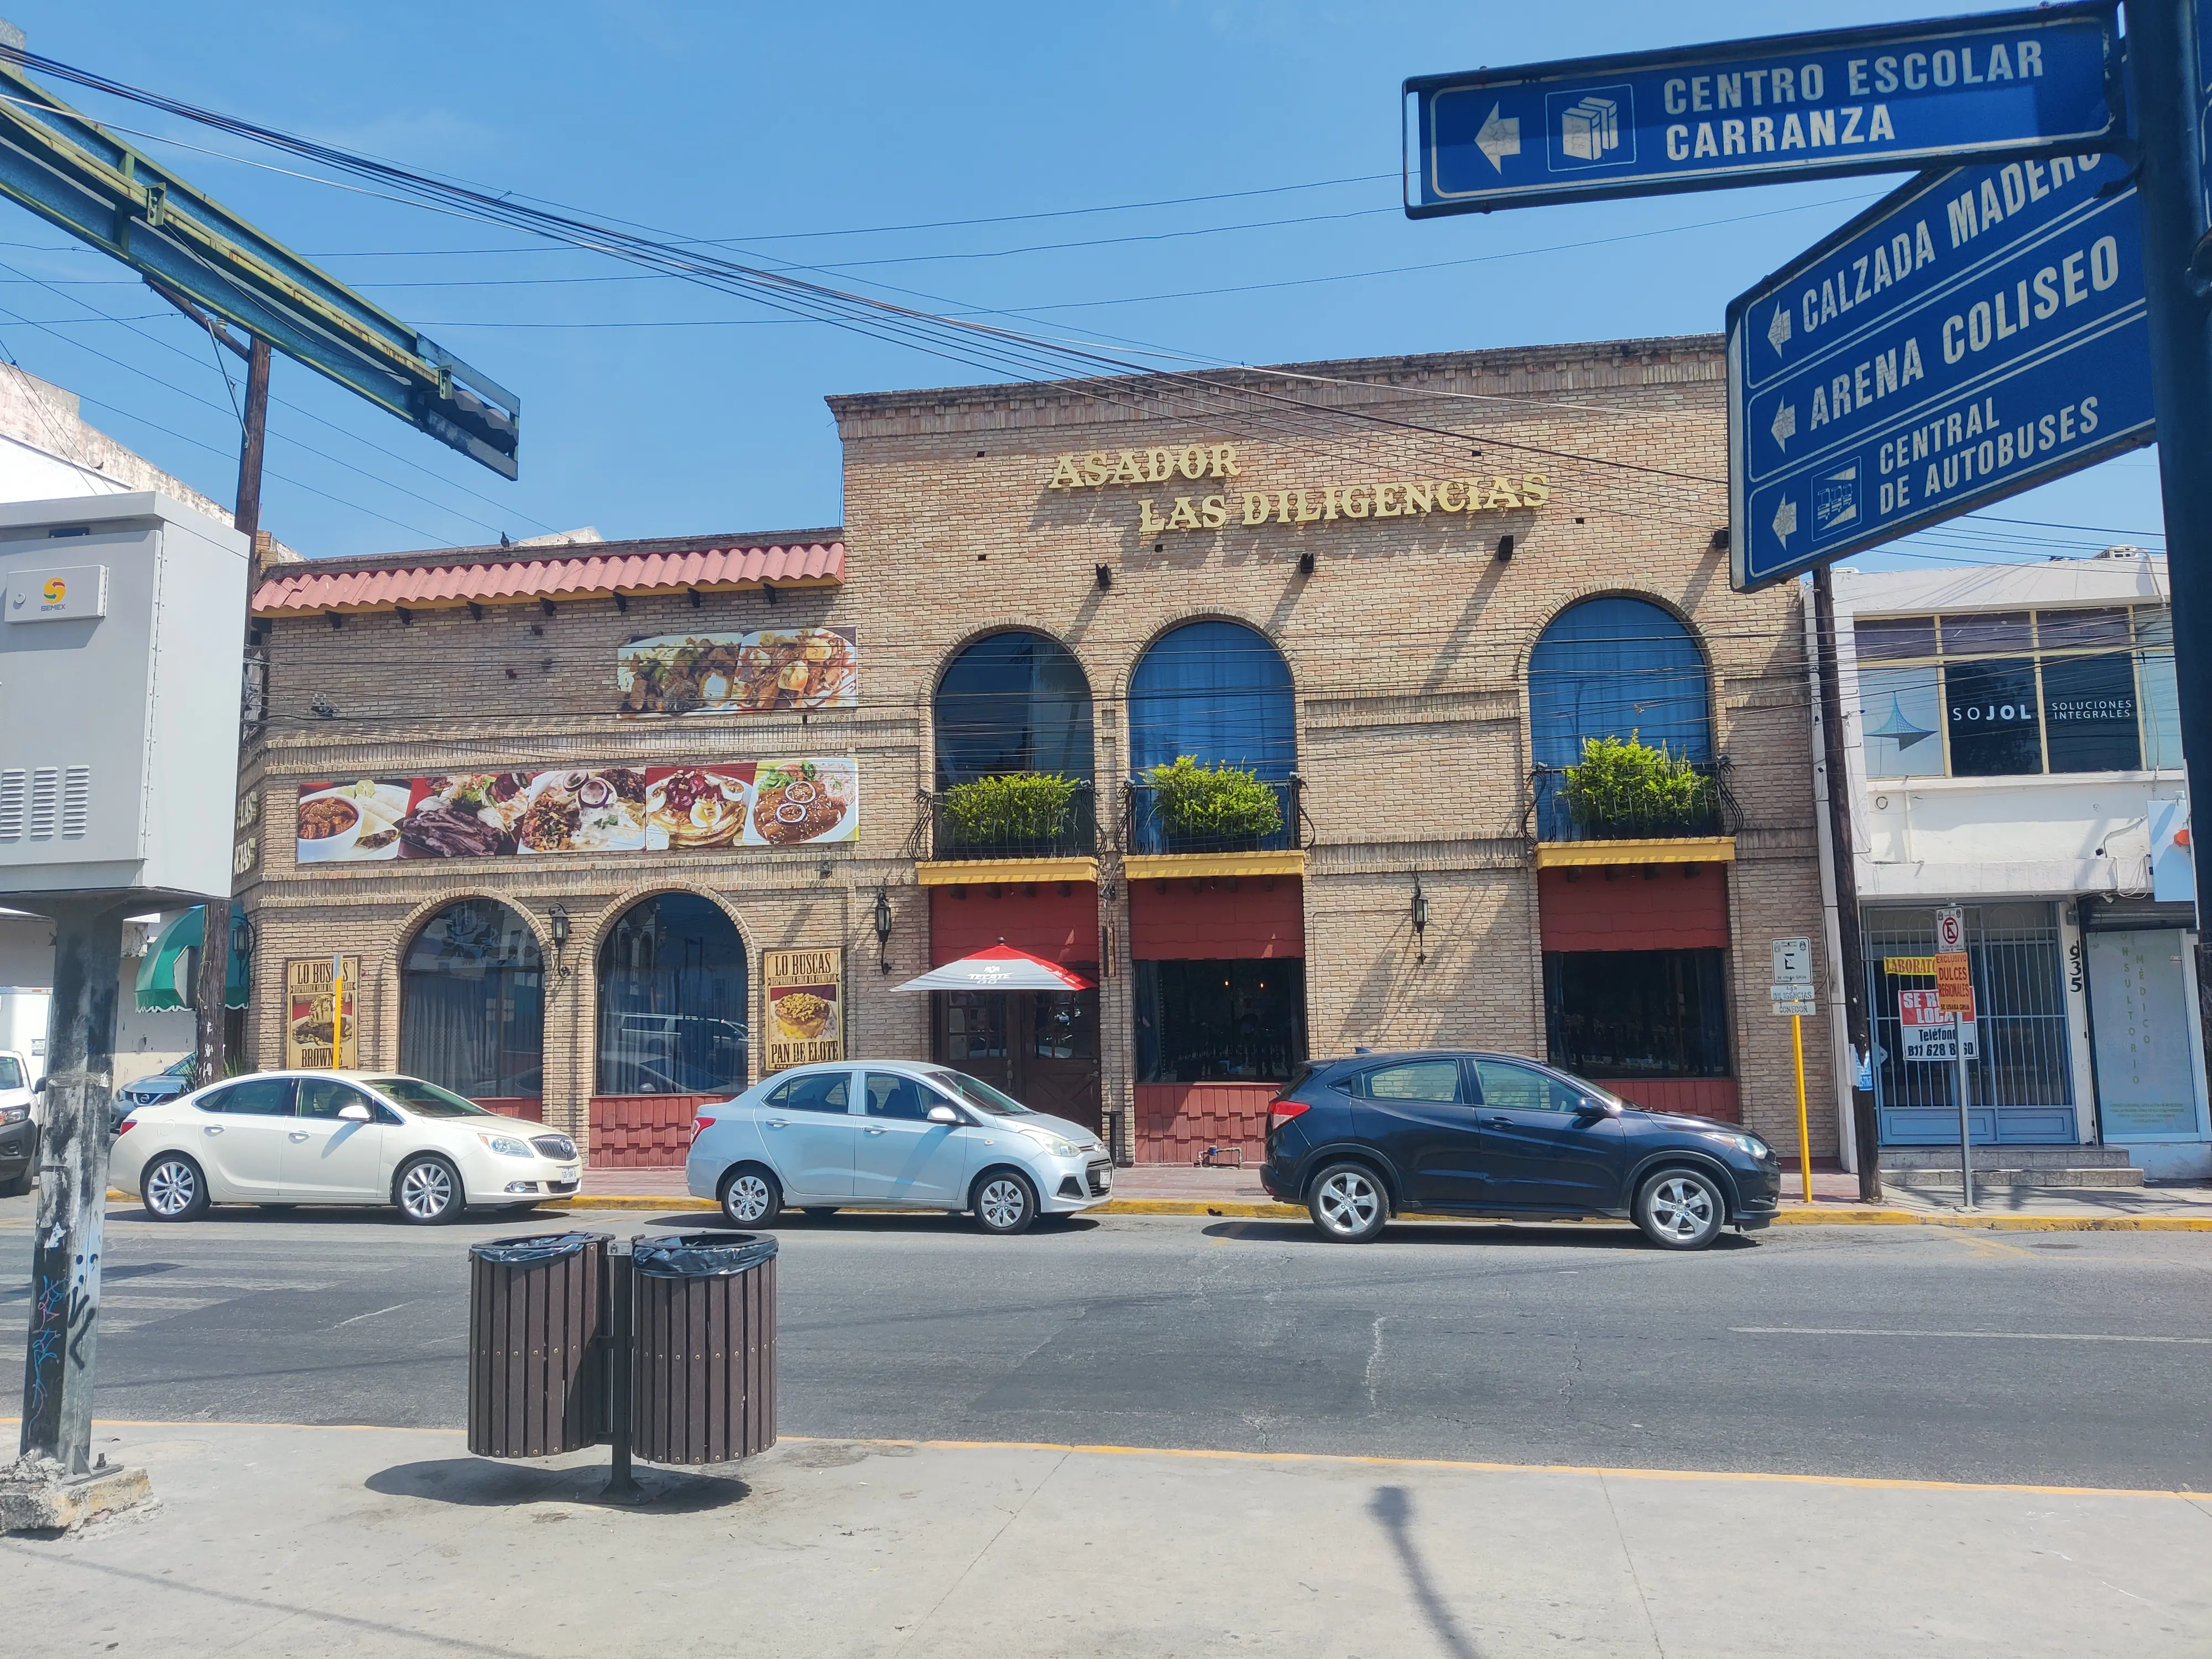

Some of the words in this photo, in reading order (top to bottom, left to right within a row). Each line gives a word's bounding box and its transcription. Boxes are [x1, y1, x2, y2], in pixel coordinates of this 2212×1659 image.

[1663, 64, 1824, 114] CENTRO
[1848, 40, 2044, 97] ESCOLAR
[1666, 103, 1896, 161] CARRANZA
[1802, 219, 1936, 333] CALZADA
[1809, 336, 1924, 431] ARENA
[1942, 235, 2119, 365] COLISEO
[1880, 396, 2000, 474] CENTRAL
[1880, 474, 1910, 515] DE
[1925, 395, 2098, 498] AUTOBUSES
[1048, 444, 1241, 489] ASADOR
[1139, 494, 1227, 533] LAS
[1241, 472, 1550, 526] DILIGENCIAS
[40, 603, 66, 612] SEMEX
[1953, 704, 2032, 721] SOJOL
[2052, 700, 2131, 711] SOLUCIONES
[2054, 709, 2130, 719] INTEGRALES
[775, 955, 788, 975] LO
[792, 953, 831, 975] BUSCAS
[1936, 954, 1966, 963] EXCLUSIVO
[2069, 940, 2082, 993] 935
[297, 964, 310, 984] LO
[312, 962, 348, 983] BUSS
[1939, 967, 1967, 981] DULCES
[1773, 992, 1812, 1000] DILIGENCIAS
[1903, 993, 1921, 1008] SE
[1939, 983, 1969, 997] REGIONALES
[301, 1047, 343, 1067] BROWNE
[771, 1044, 790, 1063] PAN
[793, 1042, 805, 1062] DE
[808, 1041, 838, 1061] ELOTE
[1908, 1045, 1923, 1056] 811
[1926, 1043, 1945, 1056] 628
